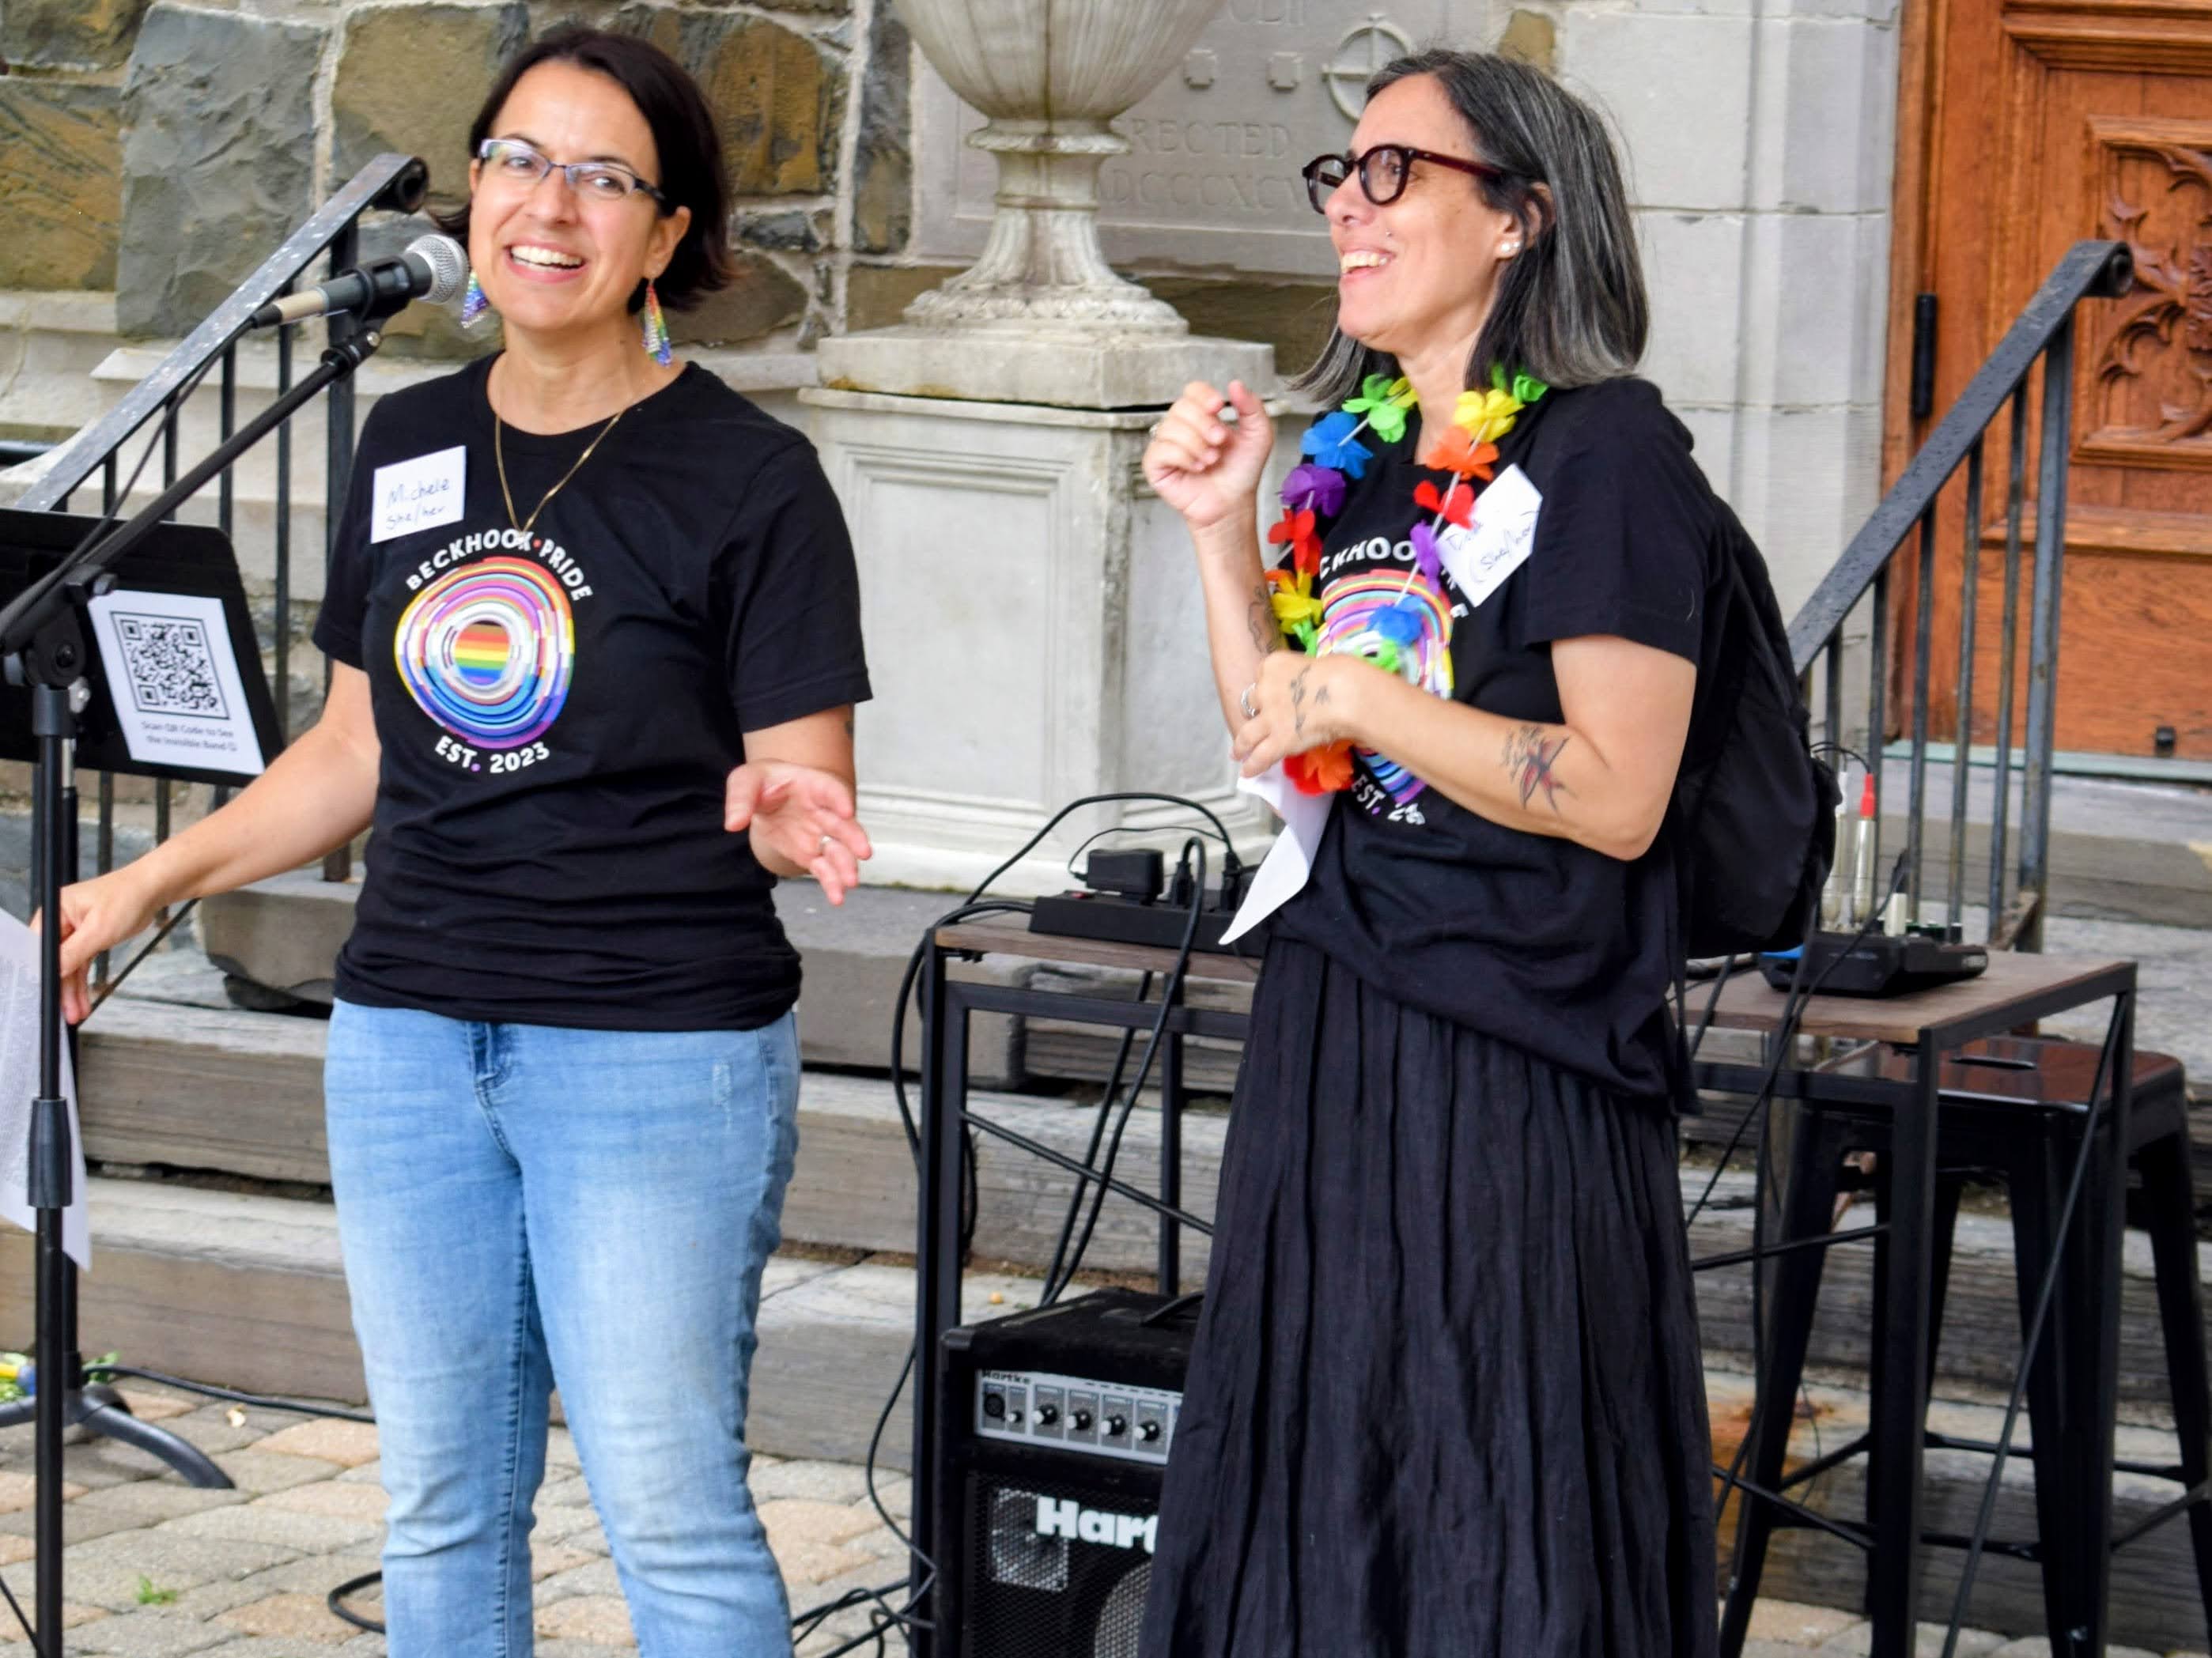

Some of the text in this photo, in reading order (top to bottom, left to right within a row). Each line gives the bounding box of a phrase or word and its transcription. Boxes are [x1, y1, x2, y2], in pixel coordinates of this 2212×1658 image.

[1129, 118, 1293, 159] RECTED
[406, 528, 593, 601] BECKHOOK PRIDE
[1320, 537, 1417, 580] CKHOO
[433, 735, 551, 774] EST. 2023
[1351, 773, 1386, 815] EST.
[1036, 1495, 1159, 1554] Hart
